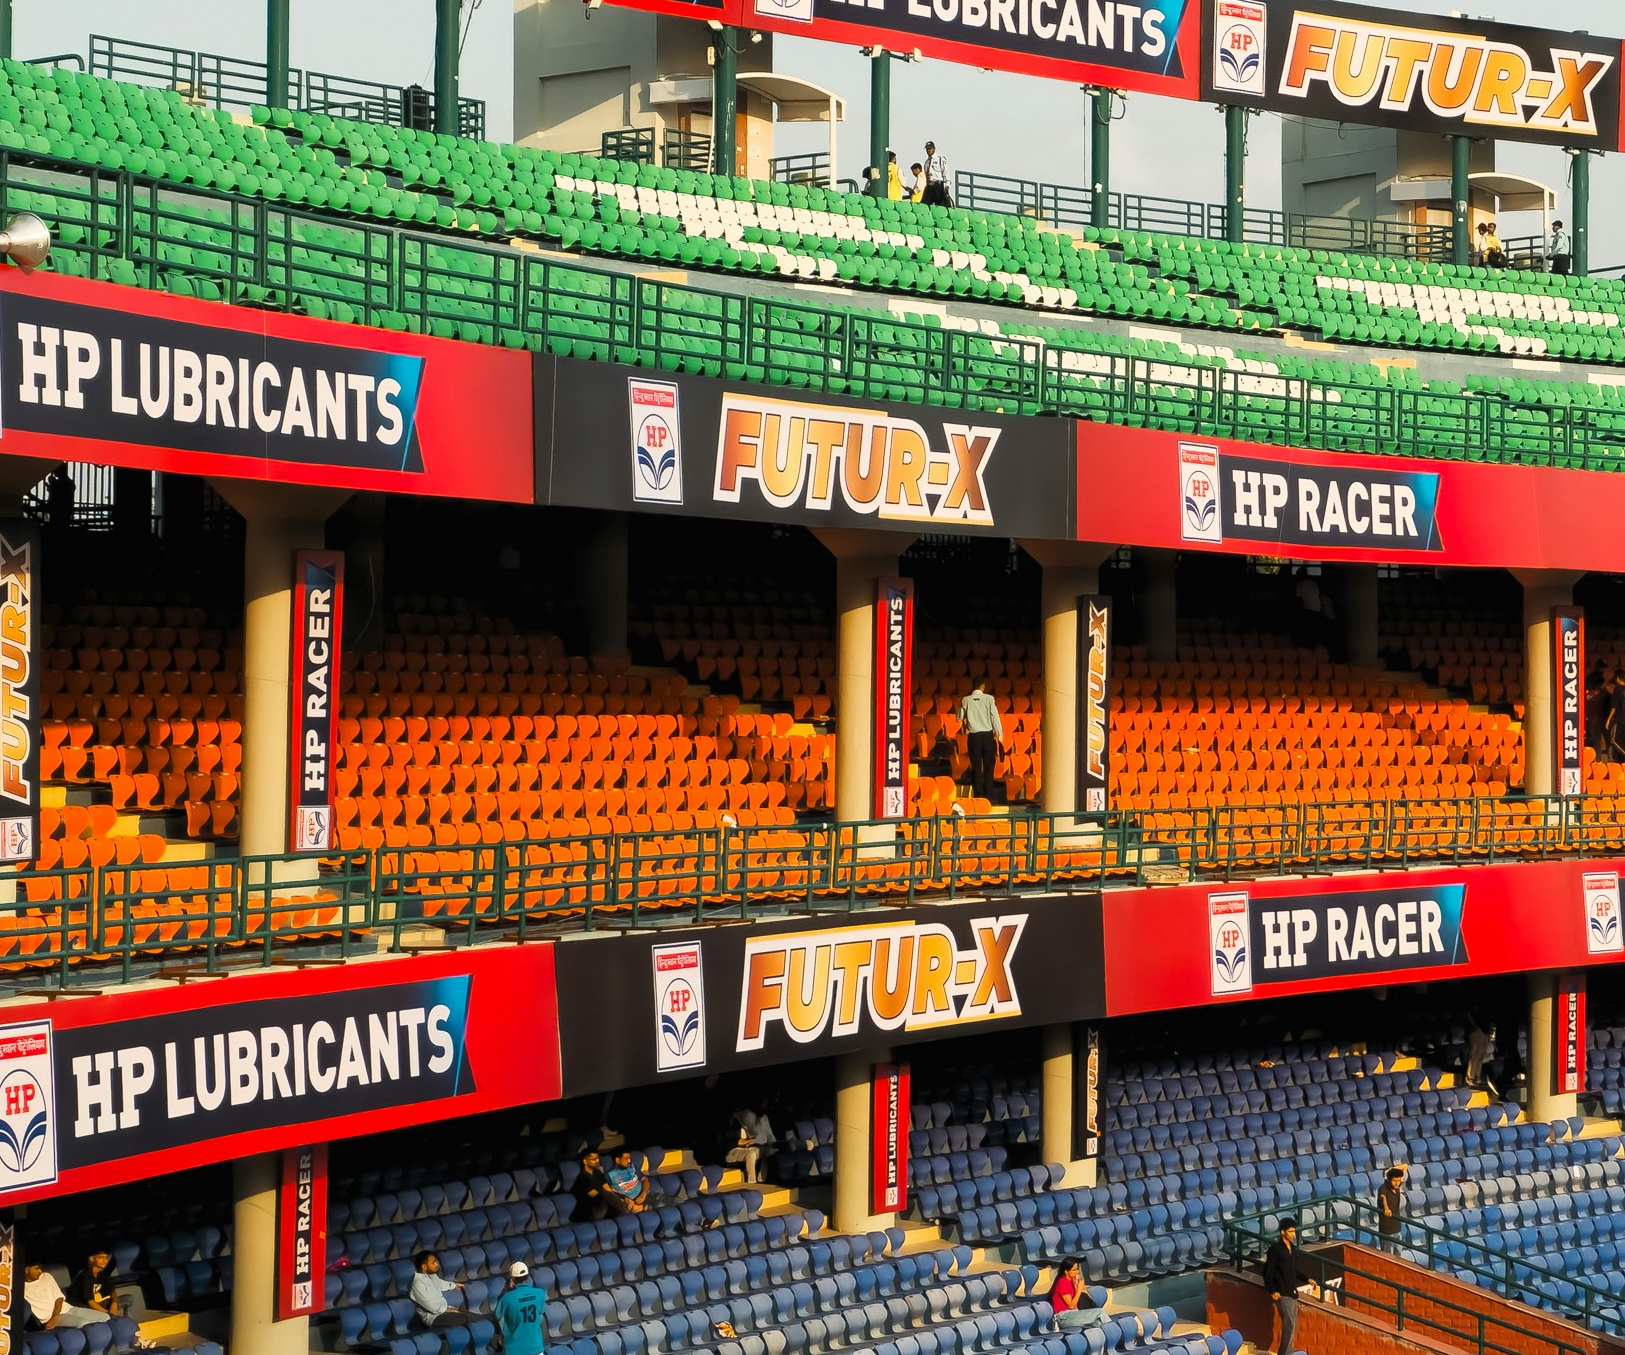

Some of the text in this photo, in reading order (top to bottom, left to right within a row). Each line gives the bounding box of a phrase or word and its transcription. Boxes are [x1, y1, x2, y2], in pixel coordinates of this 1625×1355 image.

[1231, 33, 1252, 51] HP
[1281, 18, 1608, 130] FUTUR-X
[17, 323, 403, 446] HP LUBRICANTS
[645, 425, 667, 447] HP
[714, 402, 997, 516] FUTUR-X
[1192, 479, 1209, 498] HP
[1232, 470, 1418, 537] HP RACER
[0, 536, 30, 802] FUTUR-X
[305, 588, 332, 792] HP RACER
[888, 597, 904, 780] HP LUBRICANTS
[1088, 602, 1107, 780] FUTUR-X
[1564, 630, 1578, 760] HP RACER
[738, 920, 1024, 1045] FUTUR-X
[1222, 929, 1239, 948] HP
[1262, 900, 1444, 969] HP RACER
[670, 989, 691, 1012] HP
[6, 1083, 35, 1115] HP
[73, 1004, 453, 1137] HP LUBRICANTS
[296, 1153, 312, 1275] HP RACER
[520, 1304, 537, 1323] 13
